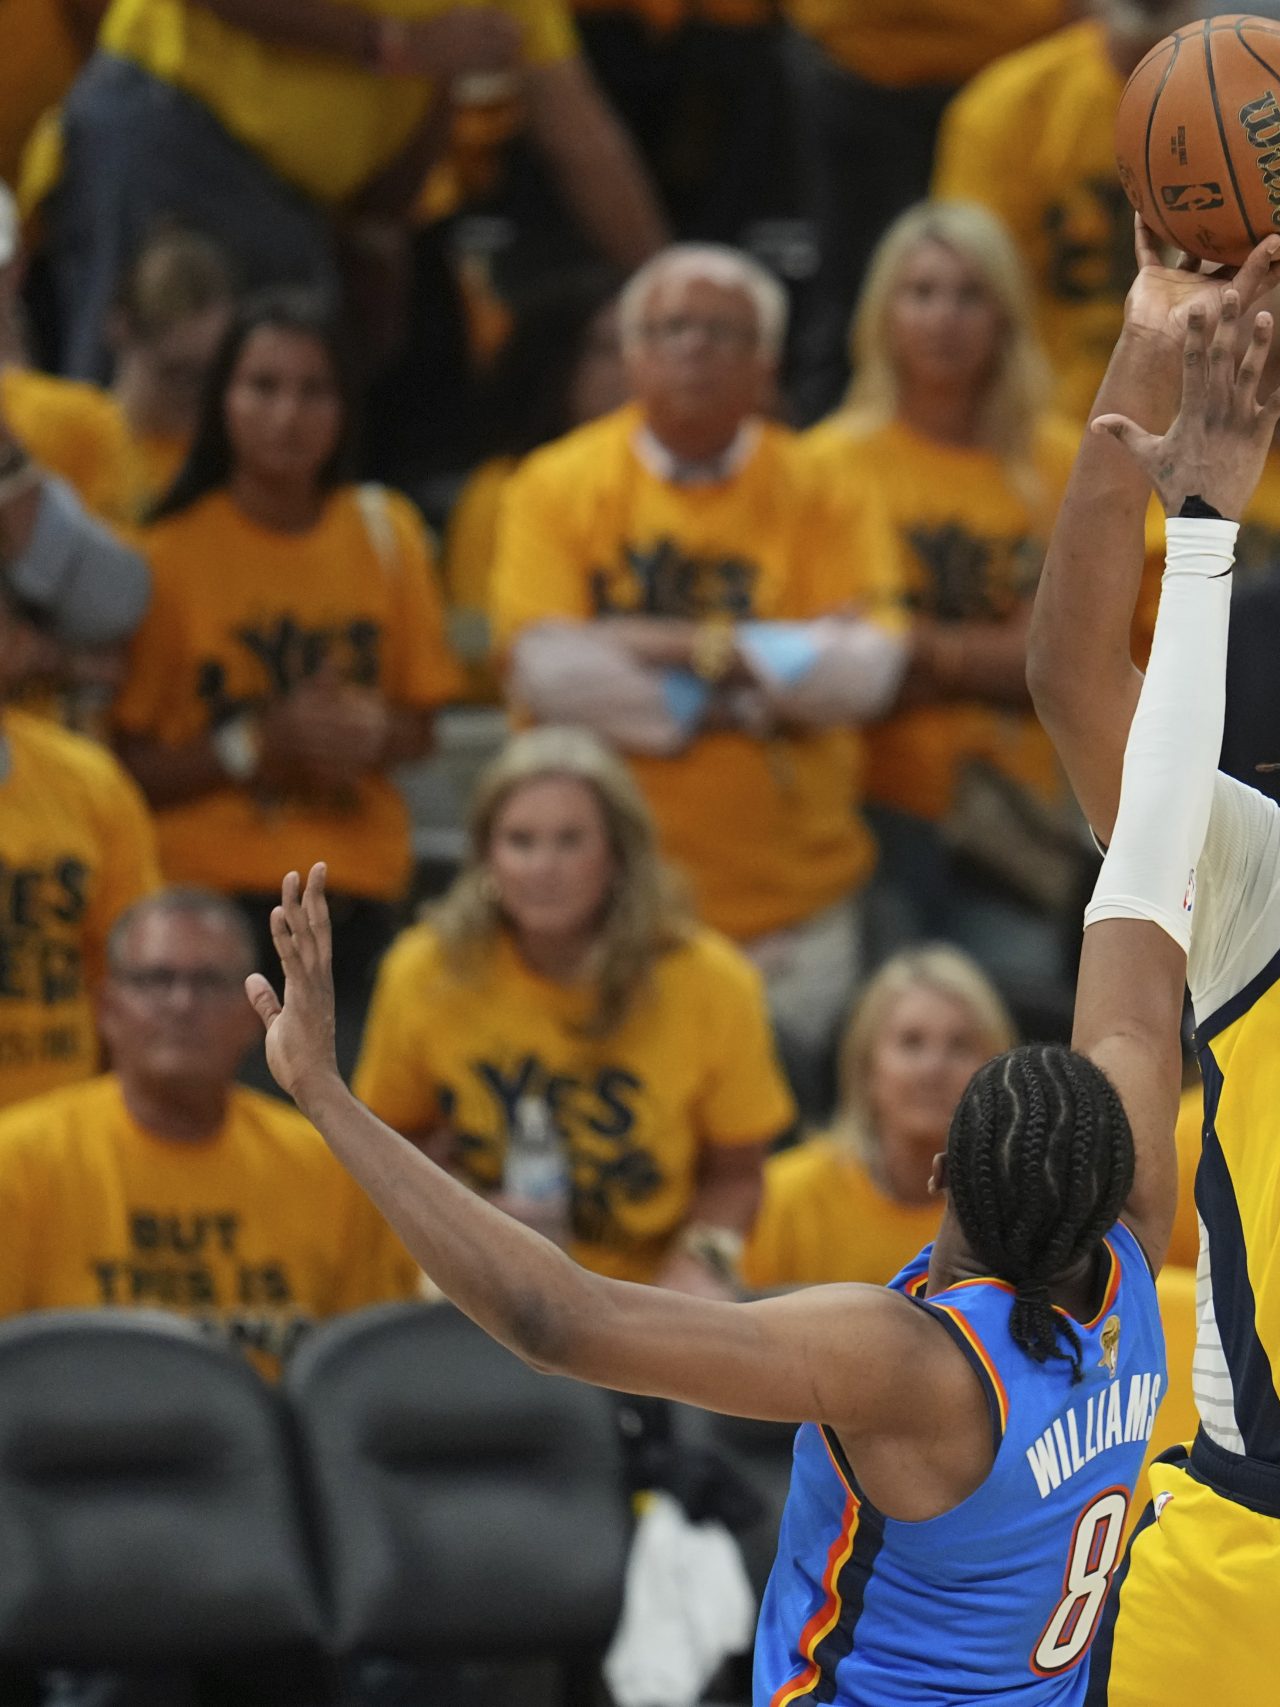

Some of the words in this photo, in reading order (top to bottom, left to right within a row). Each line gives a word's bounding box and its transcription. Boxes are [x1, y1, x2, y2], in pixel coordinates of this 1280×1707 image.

[131, 1210, 241, 1253] BUT
[1026, 1373, 1162, 1499] WILLIAMS
[1029, 1484, 1131, 1678] 8
